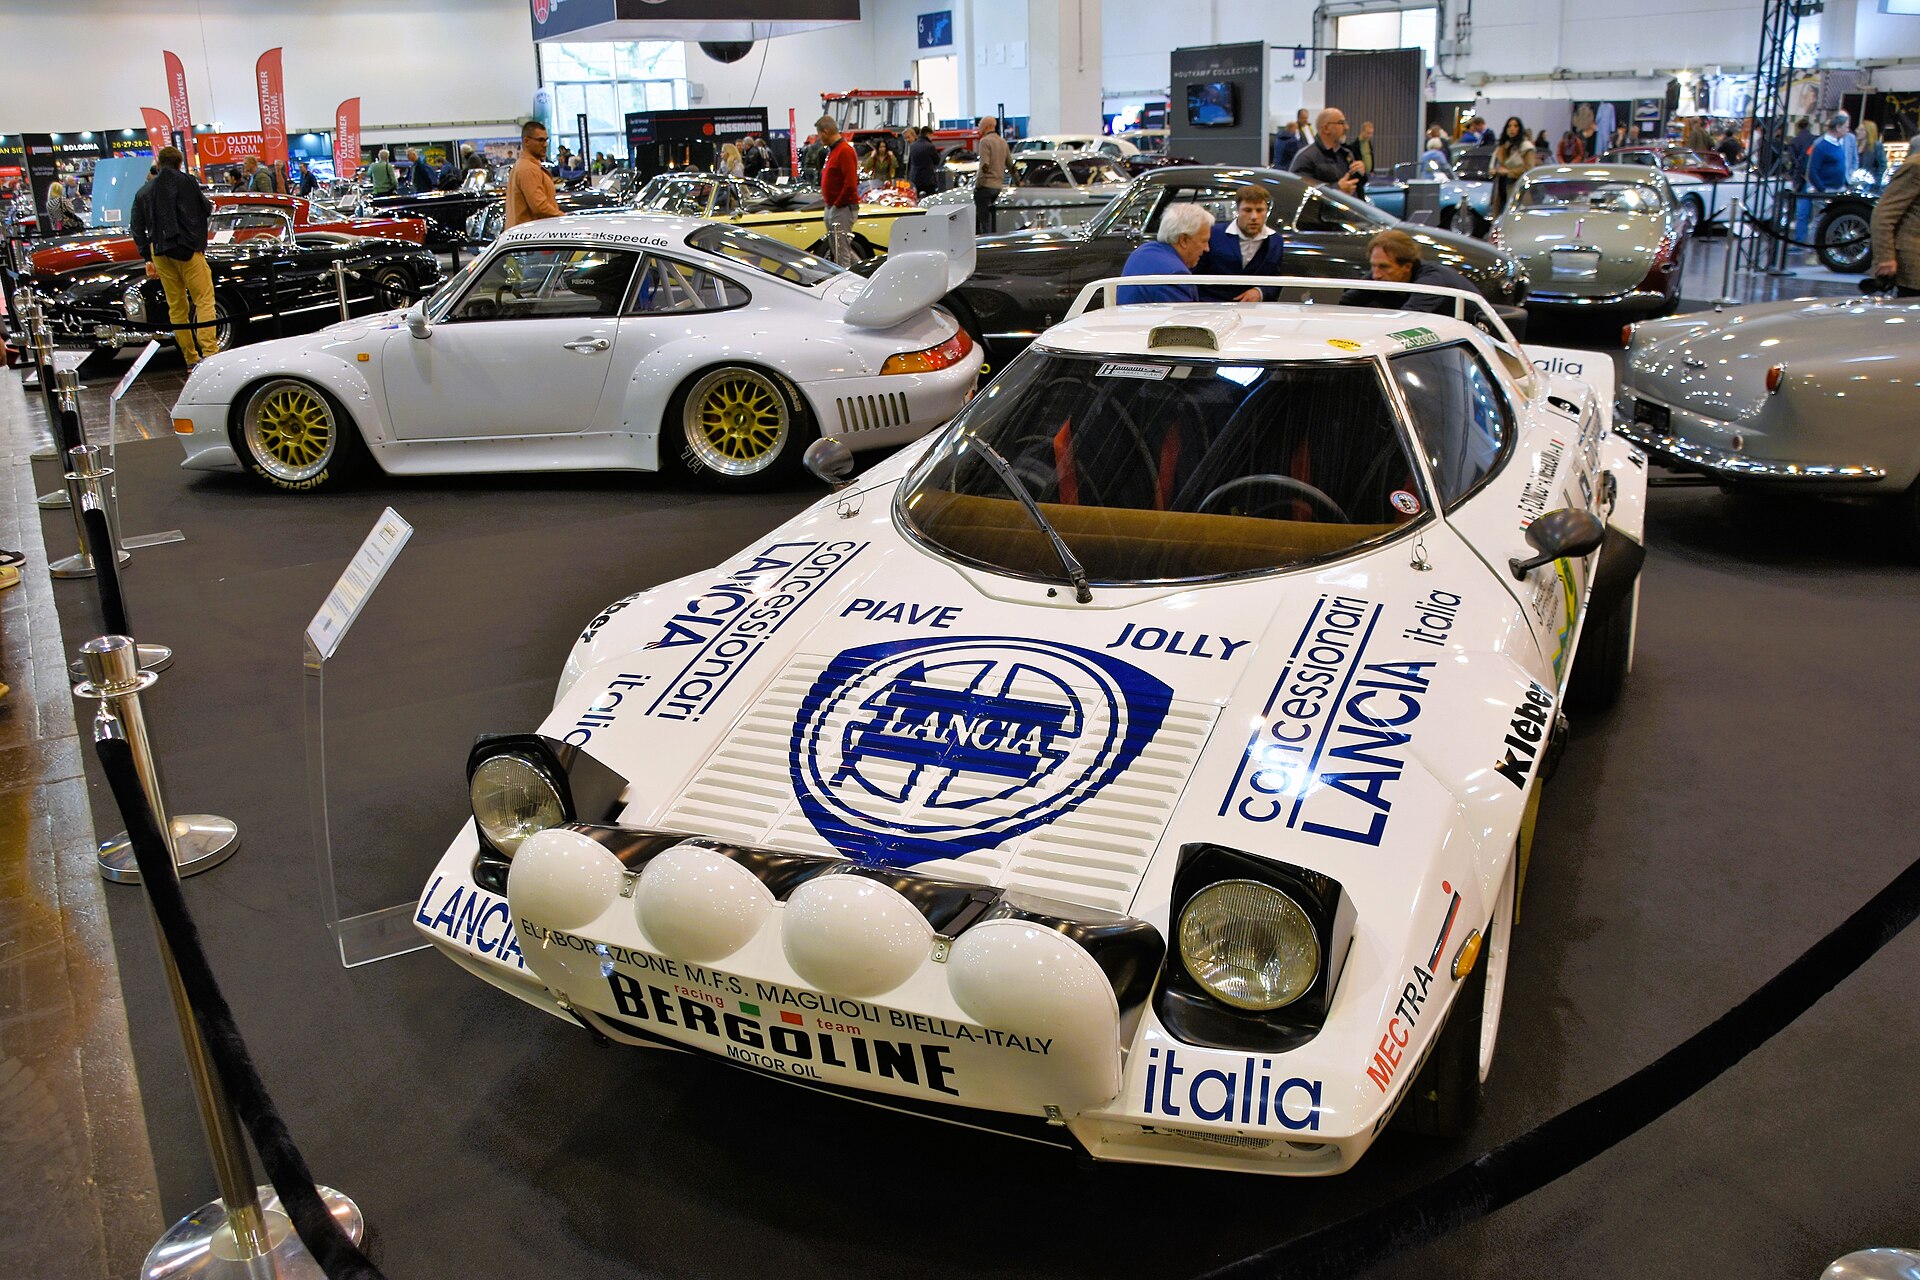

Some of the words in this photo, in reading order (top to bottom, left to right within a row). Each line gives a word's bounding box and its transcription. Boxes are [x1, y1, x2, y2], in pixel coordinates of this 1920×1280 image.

[918, 17, 925, 33] 6
[260, 70, 272, 125] OLDTIMER
[1212, 66, 1259, 77] COLLECTION
[63, 143, 100, 152] BOLOGNA
[228, 145, 261, 155] FARM.
[340, 115, 348, 159] OLDTIMER
[714, 122, 763, 136] gassmann
[251, 463, 330, 490] MICHELIN
[642, 541, 817, 651] LANCIA
[840, 598, 963, 629] PIAVE
[1403, 589, 1462, 647] italia
[658, 540, 857, 723] concessionari
[1106, 623, 1251, 662] JOLLY
[880, 711, 1044, 757] LANCIA
[1238, 594, 1369, 823] concessionari
[1301, 661, 1437, 847] LANCIA
[416, 877, 525, 969] LANCIA
[520, 918, 679, 978] ELABORAZIONE
[685, 963, 749, 997] M.F.S.
[756, 982, 881, 1023] MAGLIOLI
[890, 1008, 1053, 1055] BIELLA-ITALY
[673, 982, 725, 1009] racing
[816, 1016, 862, 1036] team
[608, 970, 960, 1097] BERGOLINE
[1366, 965, 1434, 1094] MECTRA
[726, 1044, 785, 1071] MOTOR
[791, 1062, 822, 1080] OIL
[1143, 1048, 1322, 1130] italia
